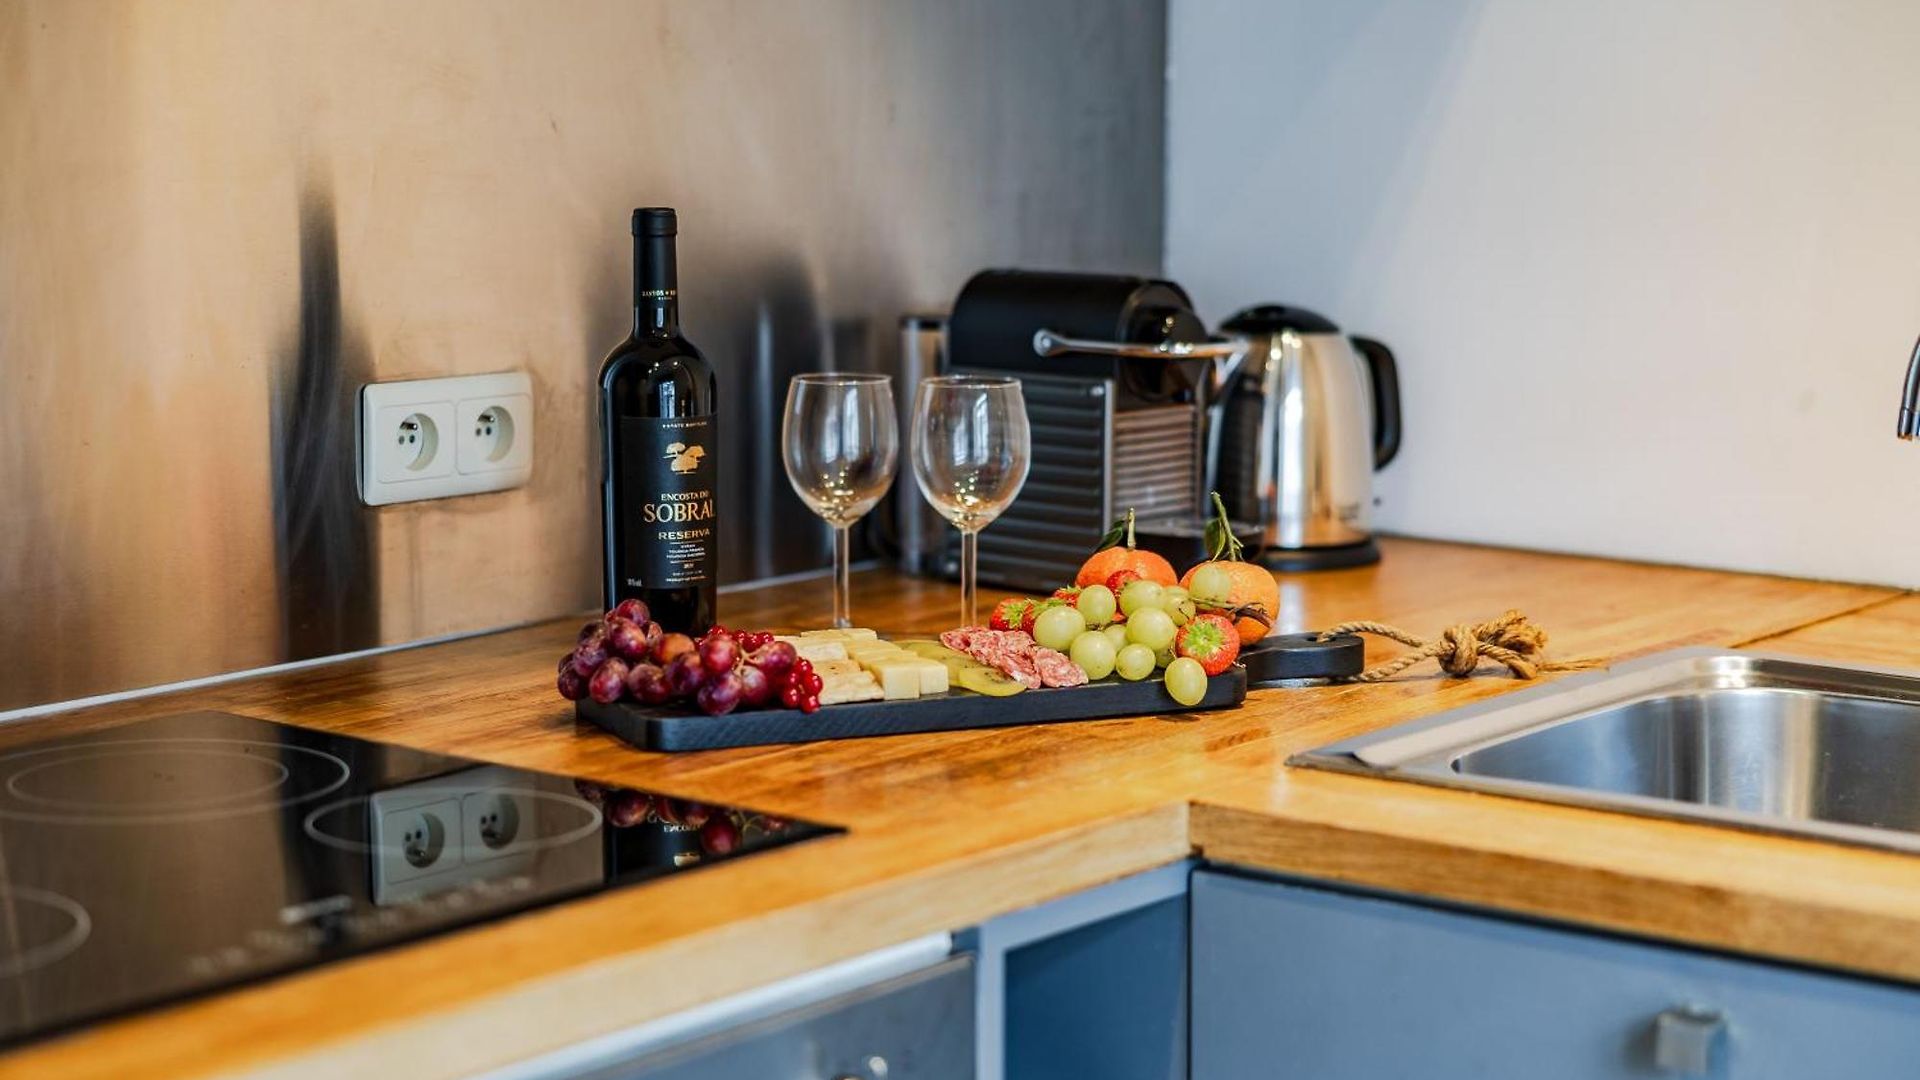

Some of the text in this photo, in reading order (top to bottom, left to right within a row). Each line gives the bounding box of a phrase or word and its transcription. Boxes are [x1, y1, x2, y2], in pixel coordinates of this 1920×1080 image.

[661, 492, 699, 501] ENCOSTA
[643, 499, 715, 523] SOBRAL
[658, 528, 710, 540] RESERVA
